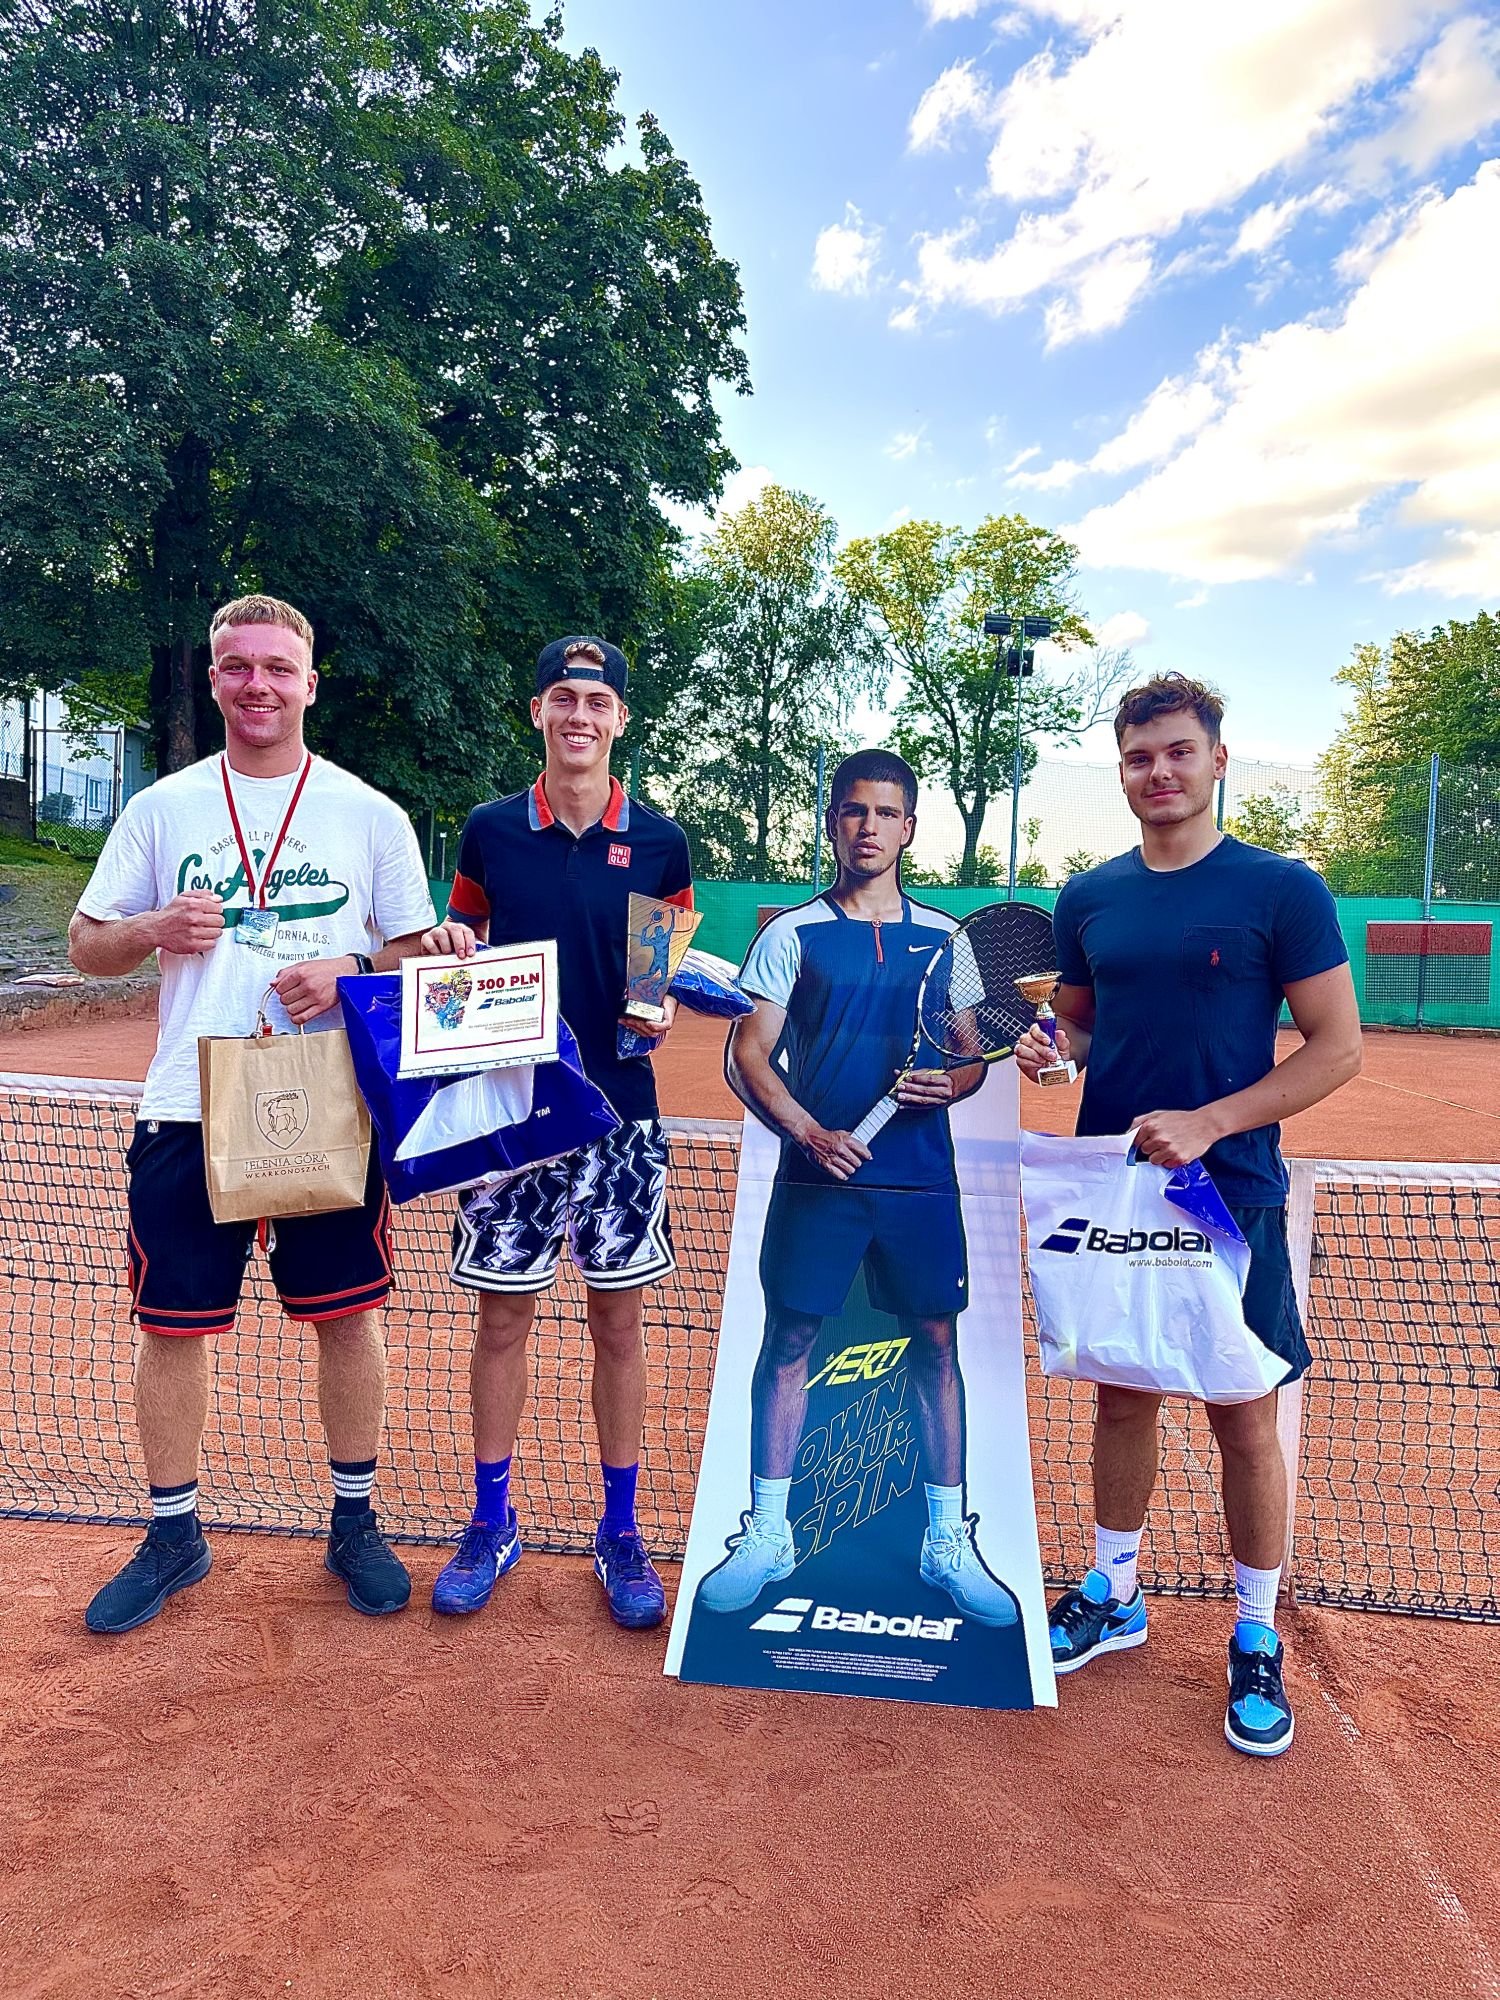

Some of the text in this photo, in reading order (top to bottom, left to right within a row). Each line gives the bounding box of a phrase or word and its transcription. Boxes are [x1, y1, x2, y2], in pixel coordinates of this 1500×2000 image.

[210, 831, 260, 855] BASELL
[611, 846, 627, 857] UNI
[610, 855, 628, 865] QLO
[214, 848, 329, 902] Ageles
[277, 952, 305, 961] VARSITY
[306, 949, 320, 960] TEAM
[477, 977, 505, 991] 300
[510, 972, 540, 987] PLN
[245, 1152, 329, 1171] JELENIA GÓRA
[1128, 1257, 1213, 1268] www.babolat.com
[791, 1367, 908, 1484] OWN
[814, 1409, 912, 1505] YOUR
[792, 1438, 920, 1568] SPIN
